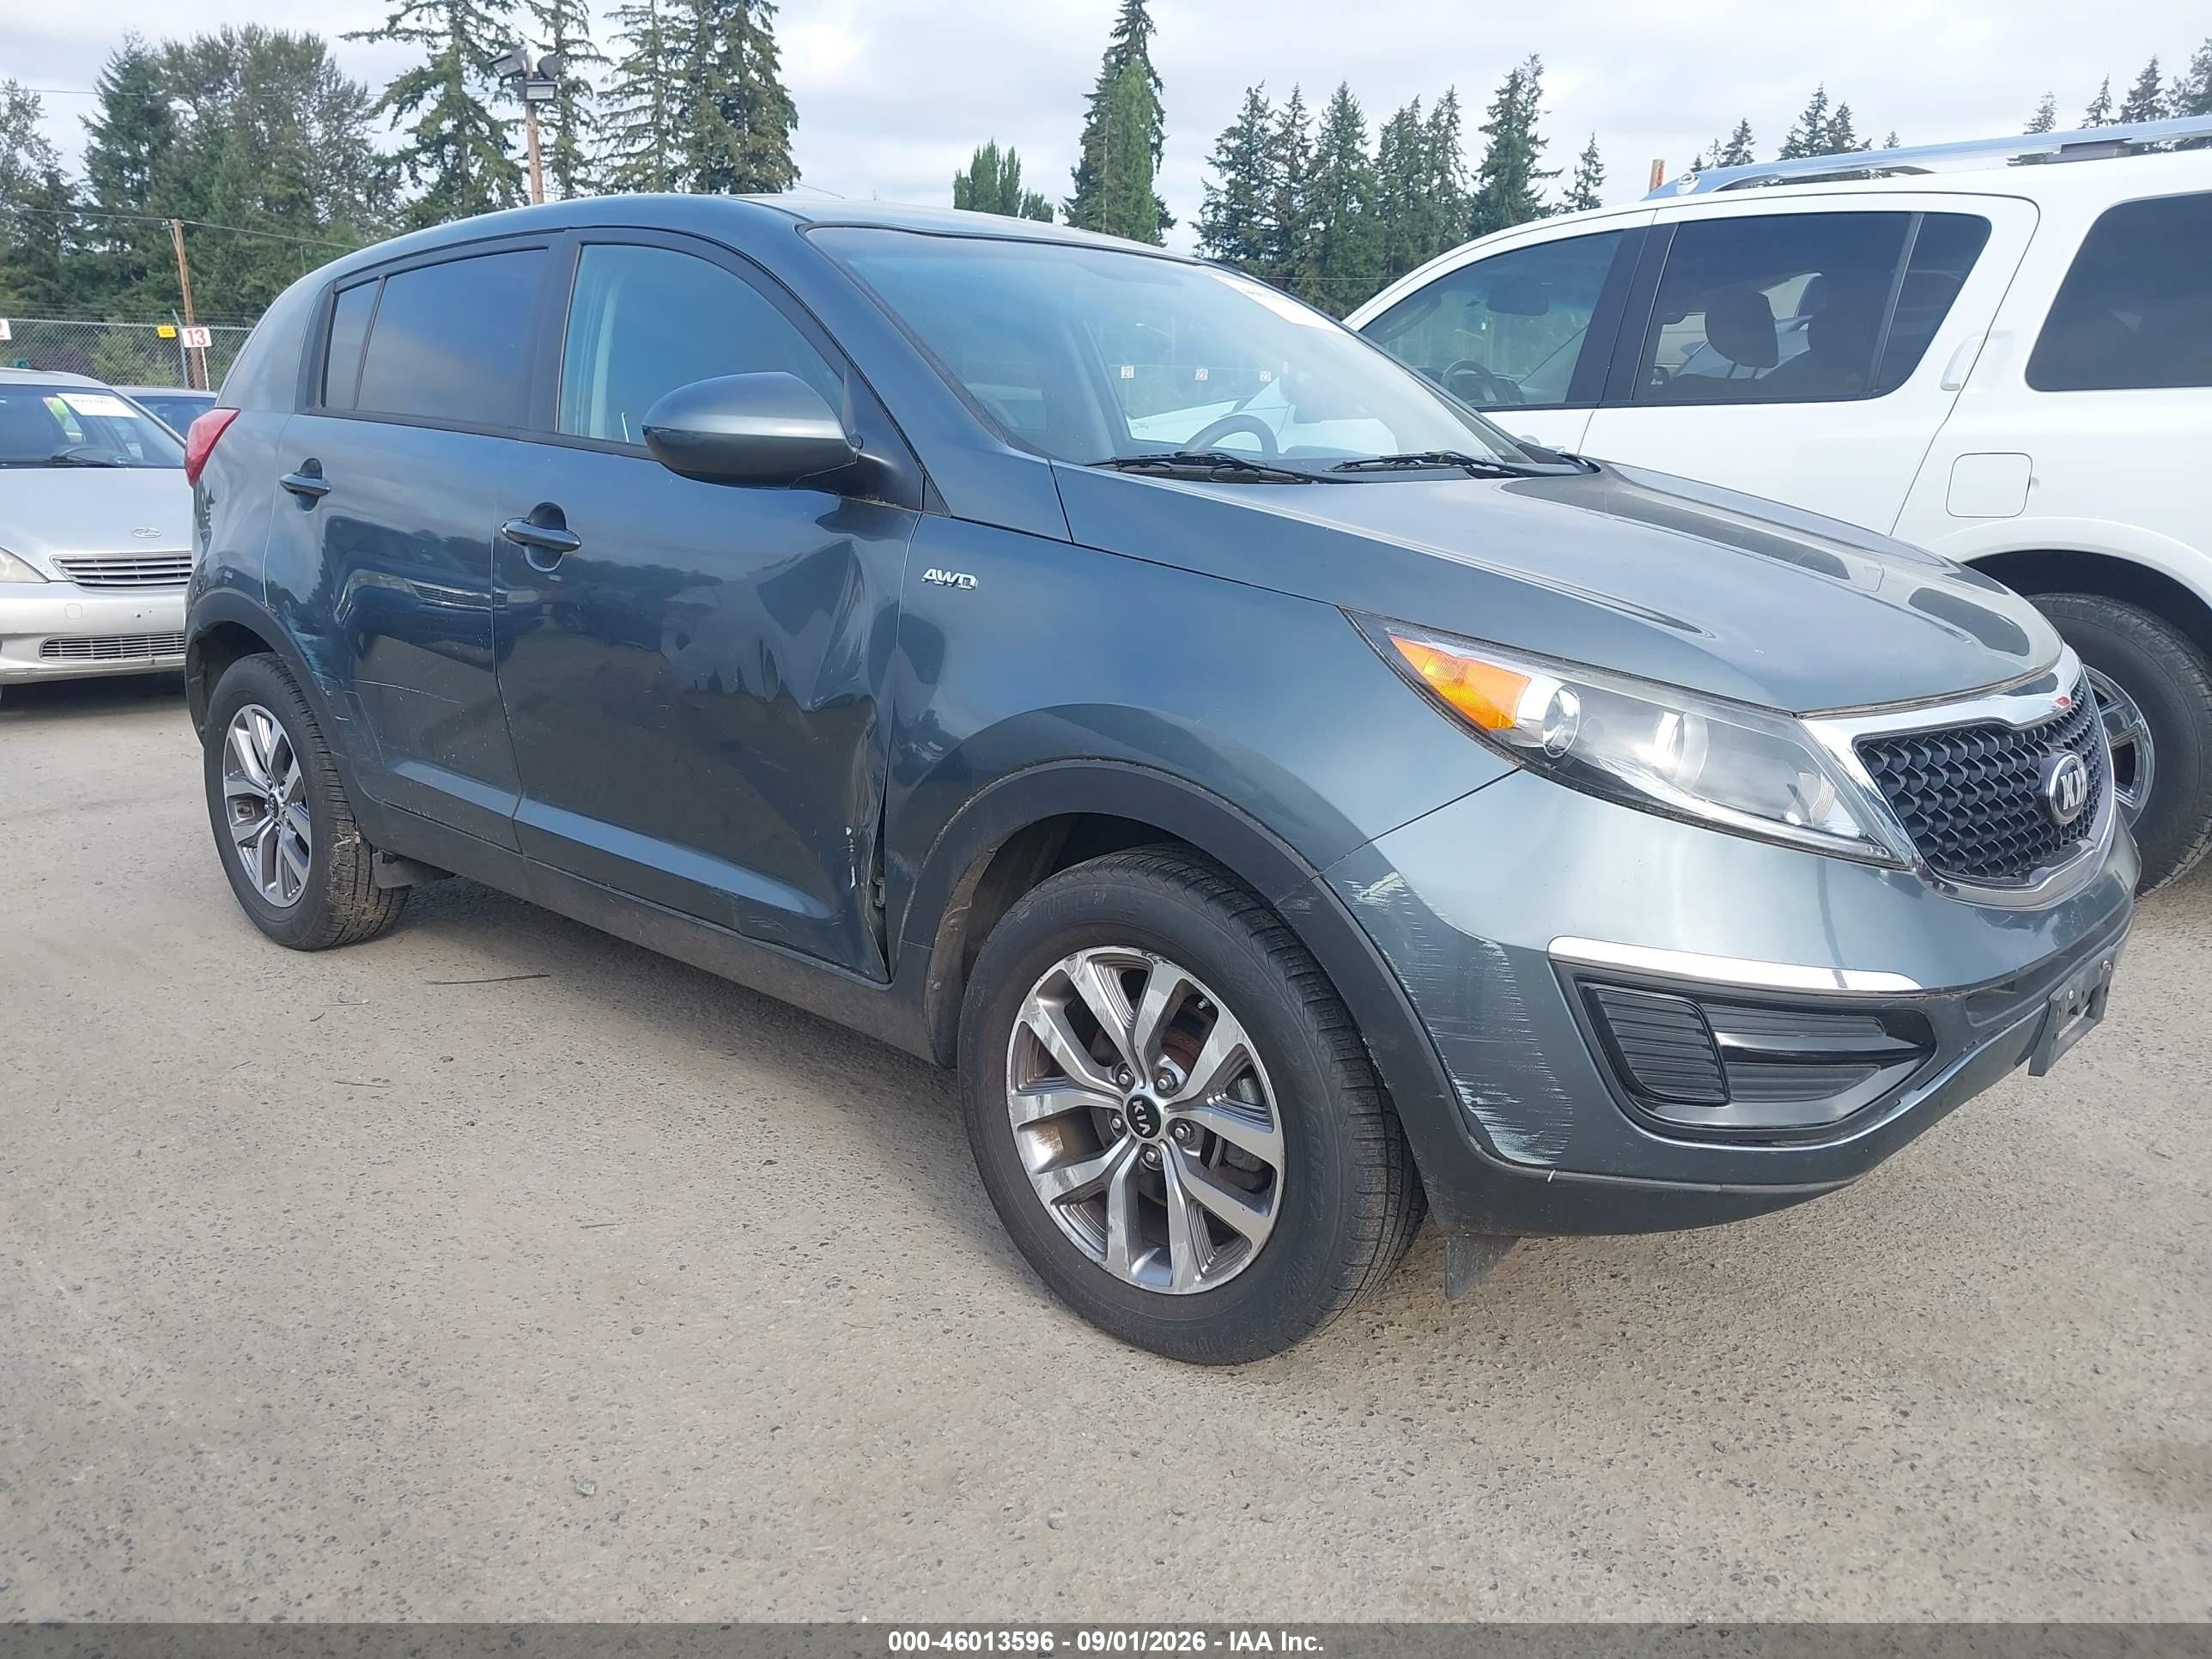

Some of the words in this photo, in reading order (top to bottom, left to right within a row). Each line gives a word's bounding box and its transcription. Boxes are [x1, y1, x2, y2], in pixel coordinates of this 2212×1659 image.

[187, 329, 207, 346] 13
[921, 568, 979, 590] AWD
[1132, 1099, 1152, 1135] KIA
